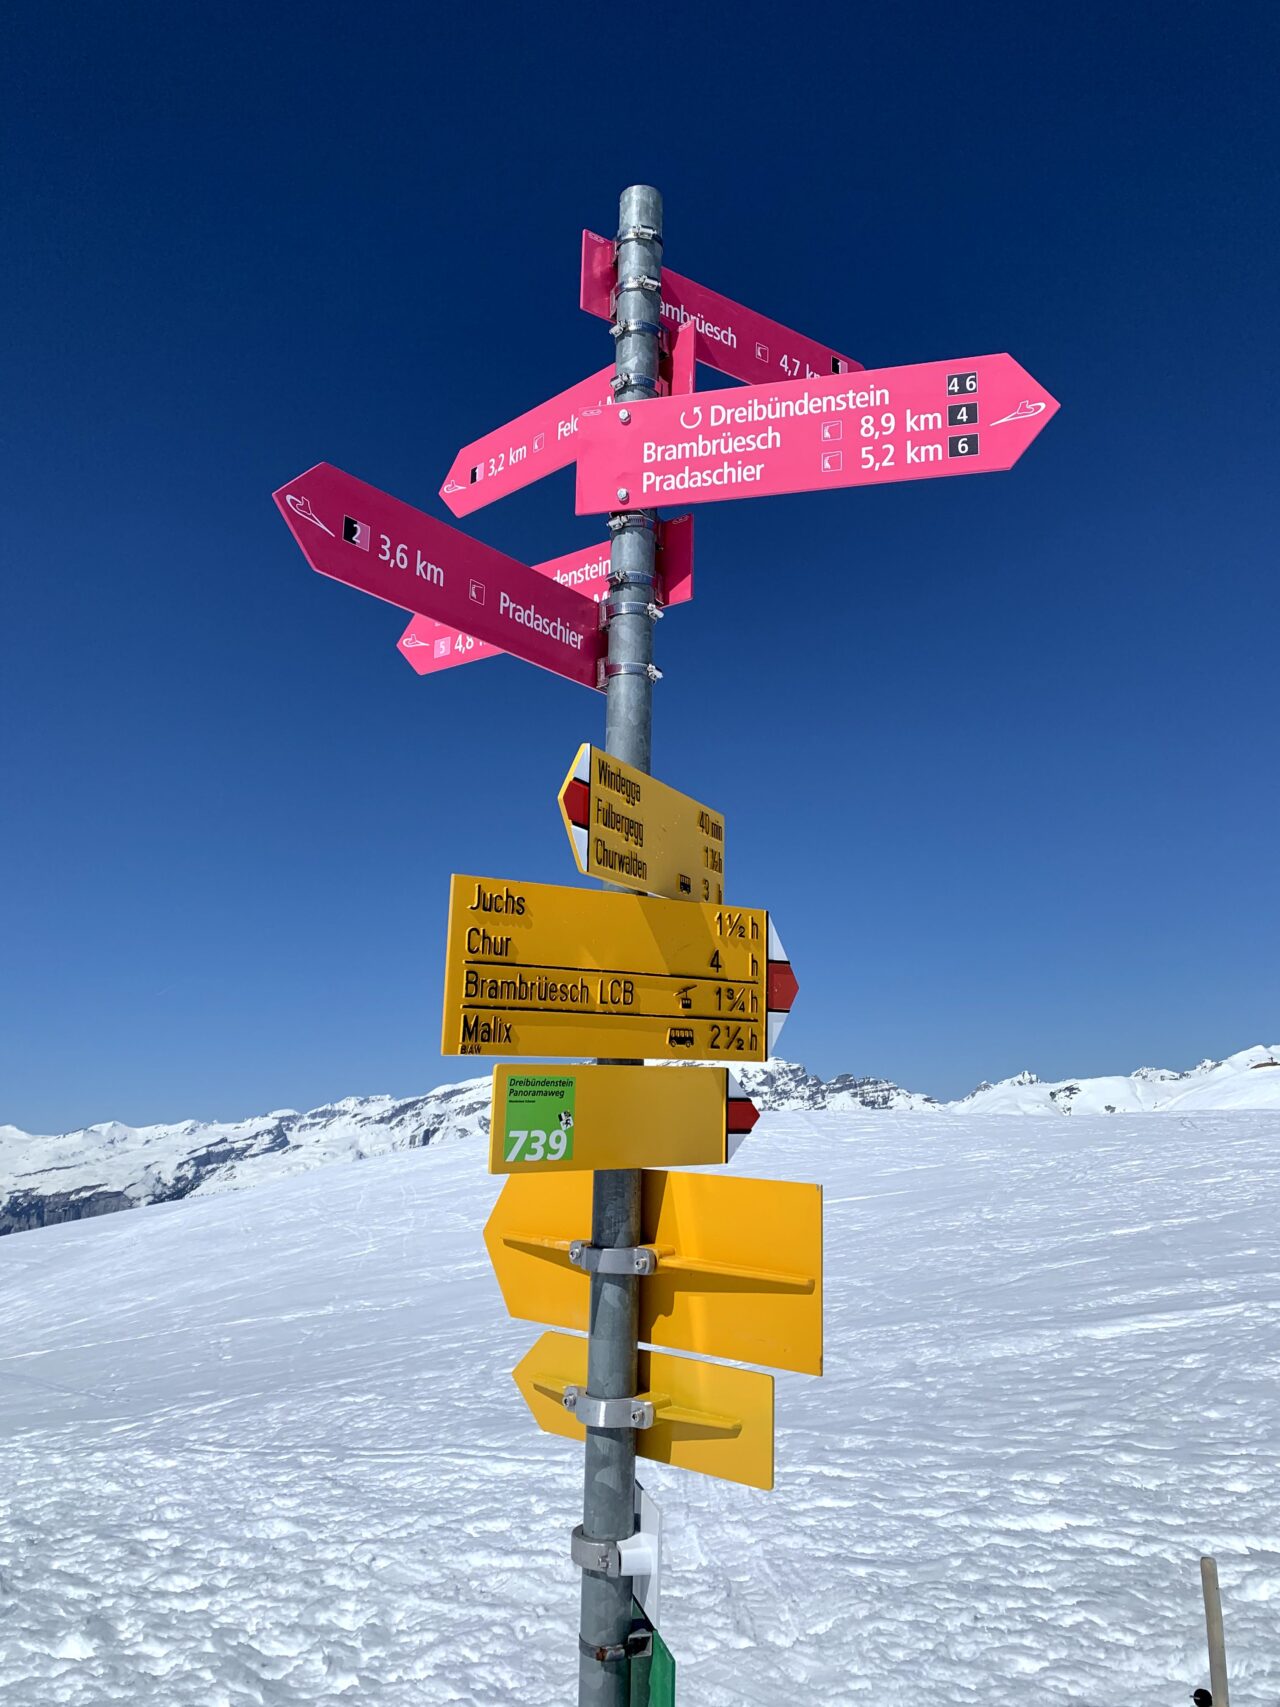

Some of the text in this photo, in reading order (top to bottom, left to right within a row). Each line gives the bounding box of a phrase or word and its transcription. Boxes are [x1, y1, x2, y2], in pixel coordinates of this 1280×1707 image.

[660, 301, 737, 349] ambrüesch
[780, 354, 801, 377] 4,7
[710, 375, 977, 427] Dreibündenstein 4 6
[643, 406, 968, 463] Brambrüesch 8,9 km 4
[488, 453, 505, 477] 3,2
[509, 445, 527, 466] km
[642, 437, 968, 494] Pradaschier 5,2 km 6
[352, 524, 584, 650] 2 3,6 km Pradaschier
[597, 798, 644, 848] Fulbergegg
[598, 758, 723, 842] Windegga 40 min
[595, 838, 647, 881] Churwalden
[702, 878, 710, 901] 3
[467, 884, 526, 916] Juchs
[749, 915, 759, 940] h
[465, 926, 758, 977] Chur 4 h
[462, 970, 590, 1005] Brambrüesch
[598, 978, 634, 1006] LCB
[749, 989, 758, 1014] h
[459, 1013, 512, 1044] Malix
[749, 1027, 758, 1051] h
[508, 1088, 565, 1099] Panoramaweg
[509, 1078, 573, 1088] Dreibündenstein
[505, 1129, 567, 1163] 739
